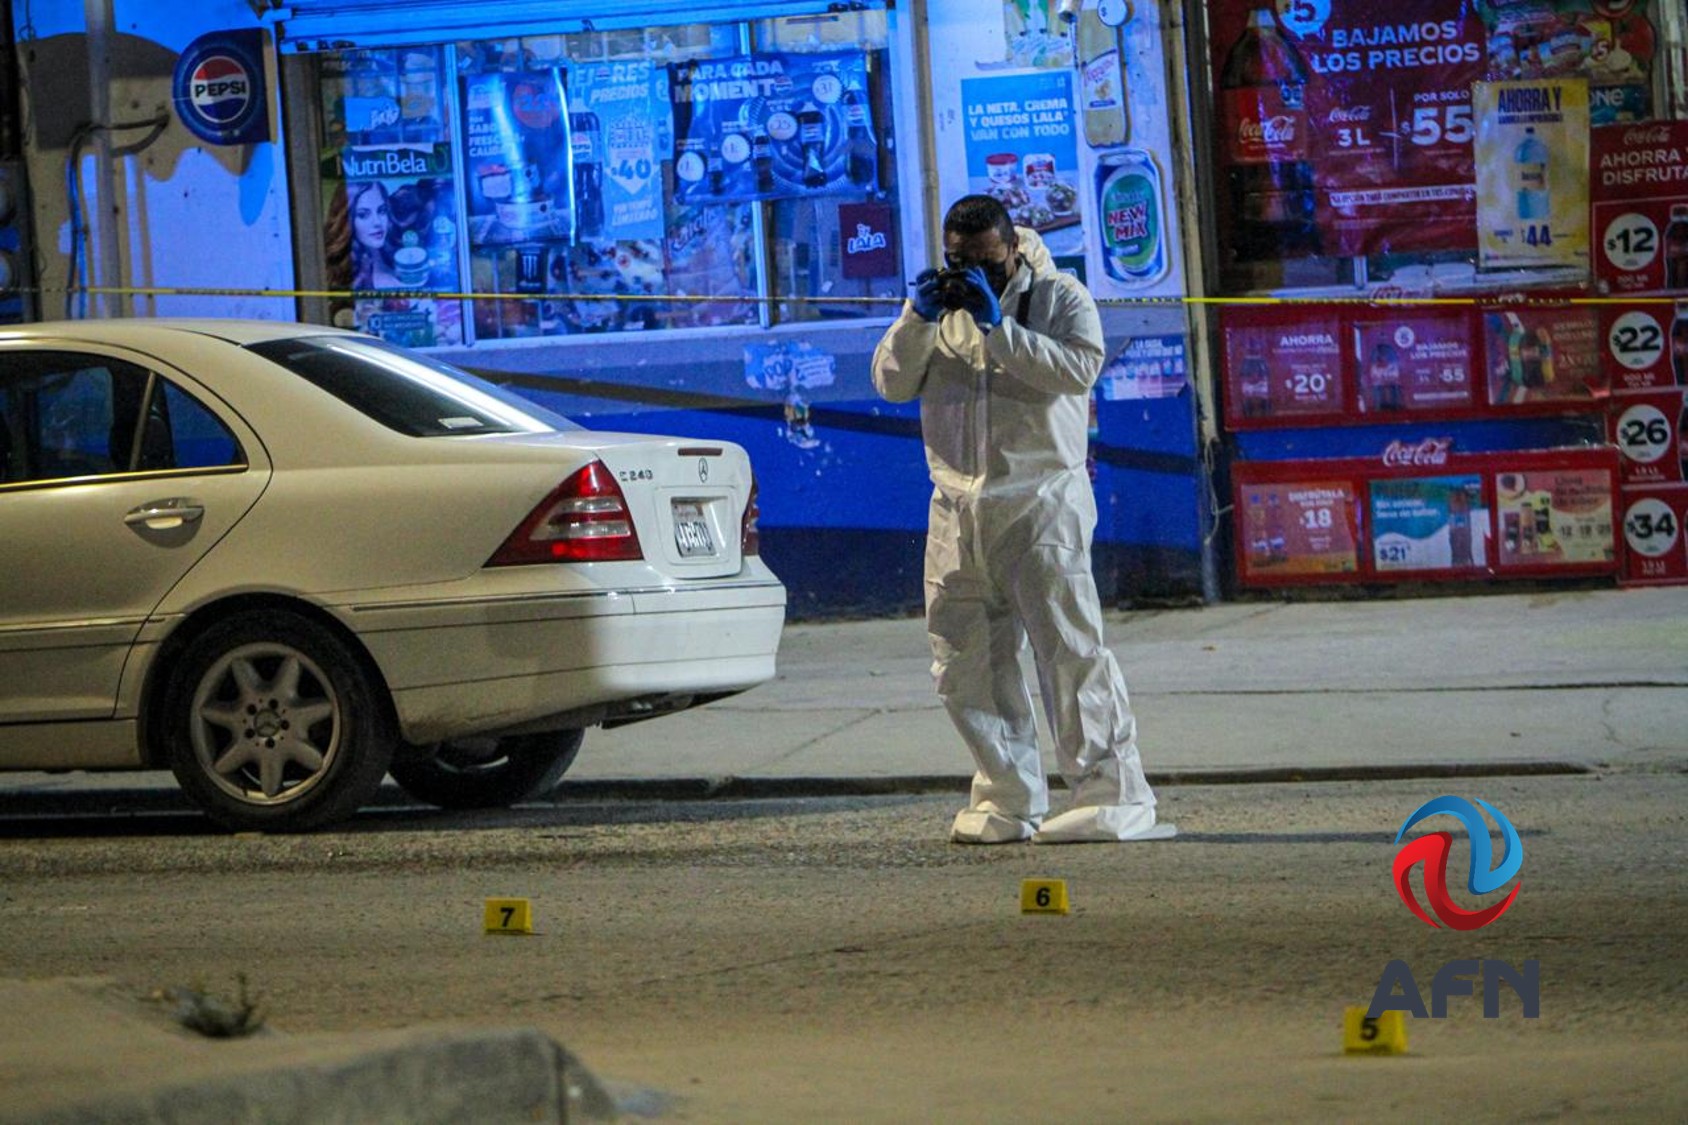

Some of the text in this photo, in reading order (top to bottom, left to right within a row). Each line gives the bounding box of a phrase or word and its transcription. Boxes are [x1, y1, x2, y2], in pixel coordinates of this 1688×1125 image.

[1332, 20, 1457, 47] BAJAMOS
[1312, 43, 1480, 73] LOS PRECIOS
[678, 61, 784, 82] PARA CADA
[194, 82, 247, 98] PEPSI
[1413, 89, 1470, 102] POR SOLO
[1498, 86, 1562, 112] AHORRA Y
[968, 104, 984, 116] LA
[1024, 98, 1068, 112] CREMA
[969, 117, 978, 127] Y
[981, 114, 1029, 127] QUESOS
[1002, 126, 1029, 140] CON
[1033, 123, 1070, 137] TODO
[1601, 149, 1680, 168] AHORRA
[1108, 203, 1146, 225] NEW
[1115, 223, 1147, 240] MIX
[1608, 227, 1655, 254] $12
[1281, 334, 1334, 346] AHORRA
[1612, 325, 1660, 353] $22
[1620, 419, 1668, 446] $26
[630, 470, 653, 482] 240
[1627, 513, 1675, 539] $34
[1036, 887, 1051, 907] 6
[500, 907, 516, 927] 7
[1360, 1017, 1379, 1041] 5
